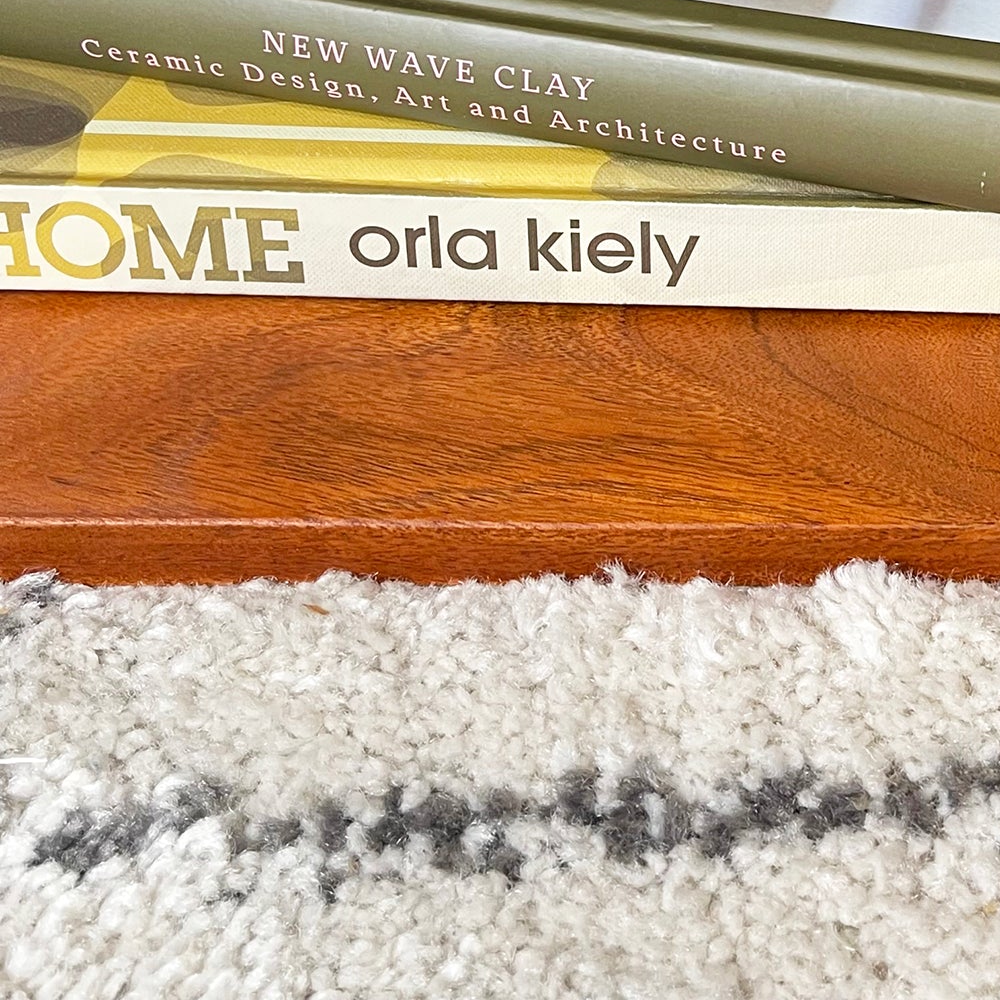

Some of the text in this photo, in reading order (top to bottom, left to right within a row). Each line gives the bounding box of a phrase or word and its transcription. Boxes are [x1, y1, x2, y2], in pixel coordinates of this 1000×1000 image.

[80, 38, 787, 163] Ceramic Design, Art and Architecture
[262, 30, 595, 101] NEW WAVE CLAY
[349, 215, 498, 270] orla
[527, 218, 700, 287] kiely
